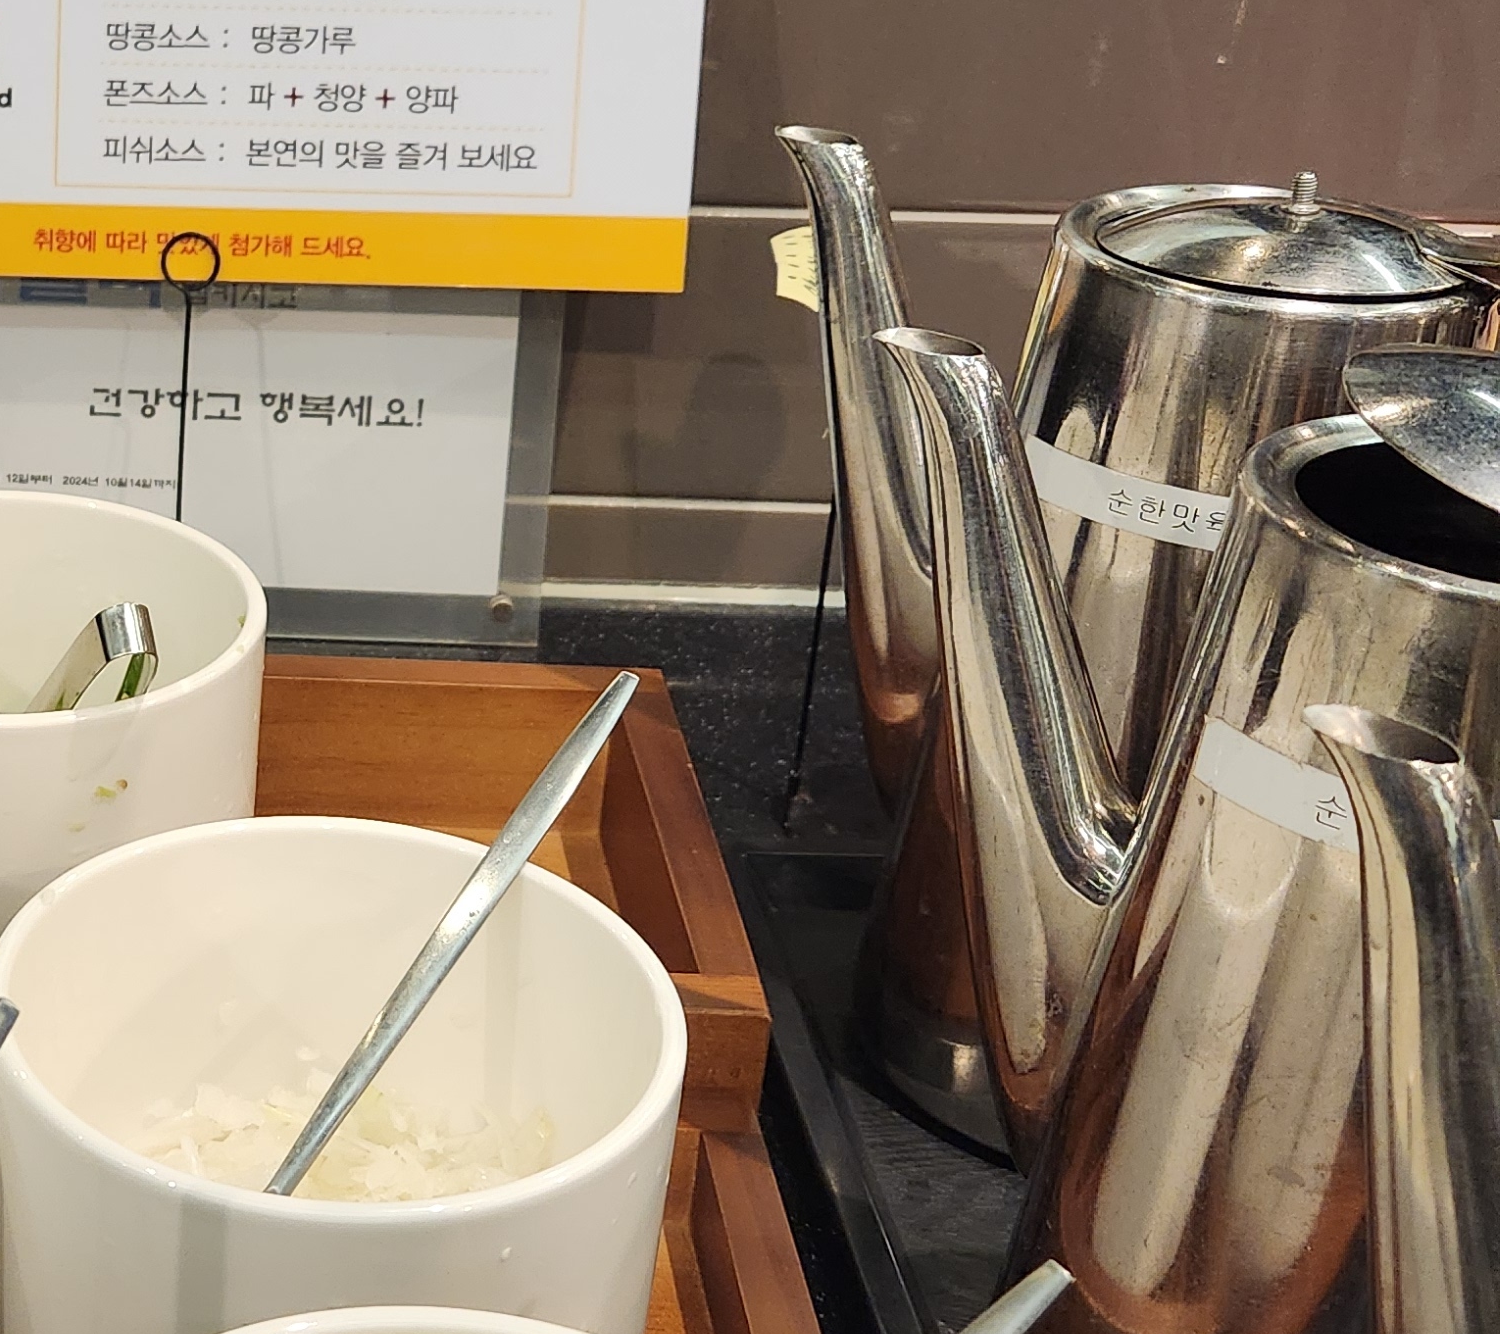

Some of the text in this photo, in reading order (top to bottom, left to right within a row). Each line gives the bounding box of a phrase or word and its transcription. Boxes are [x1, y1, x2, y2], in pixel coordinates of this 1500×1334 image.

[105, 21, 211, 52] 땅콩소스
[251, 24, 357, 55] 땅콩가루
[102, 79, 208, 107] 폰즈소스
[248, 81, 276, 111] 파
[282, 86, 304, 108] +
[312, 82, 368, 114] 청양
[374, 88, 396, 110] +
[405, 84, 460, 115] 양파
[102, 135, 207, 165] 피쉬소스
[244, 138, 325, 168] 본연의
[334, 139, 387, 170] 맛을
[394, 141, 448, 171] 즐겨
[456, 142, 539, 173] 보세요
[32, 228, 97, 254] 취향에
[104, 230, 148, 255] 따라
[227, 233, 294, 259] 첨가해
[300, 235, 372, 261] 드세요.
[88, 387, 426, 428] 건강하고 행복세요!
[62, 475, 99, 487] 2024년
[1314, 795, 1348, 831] 순
